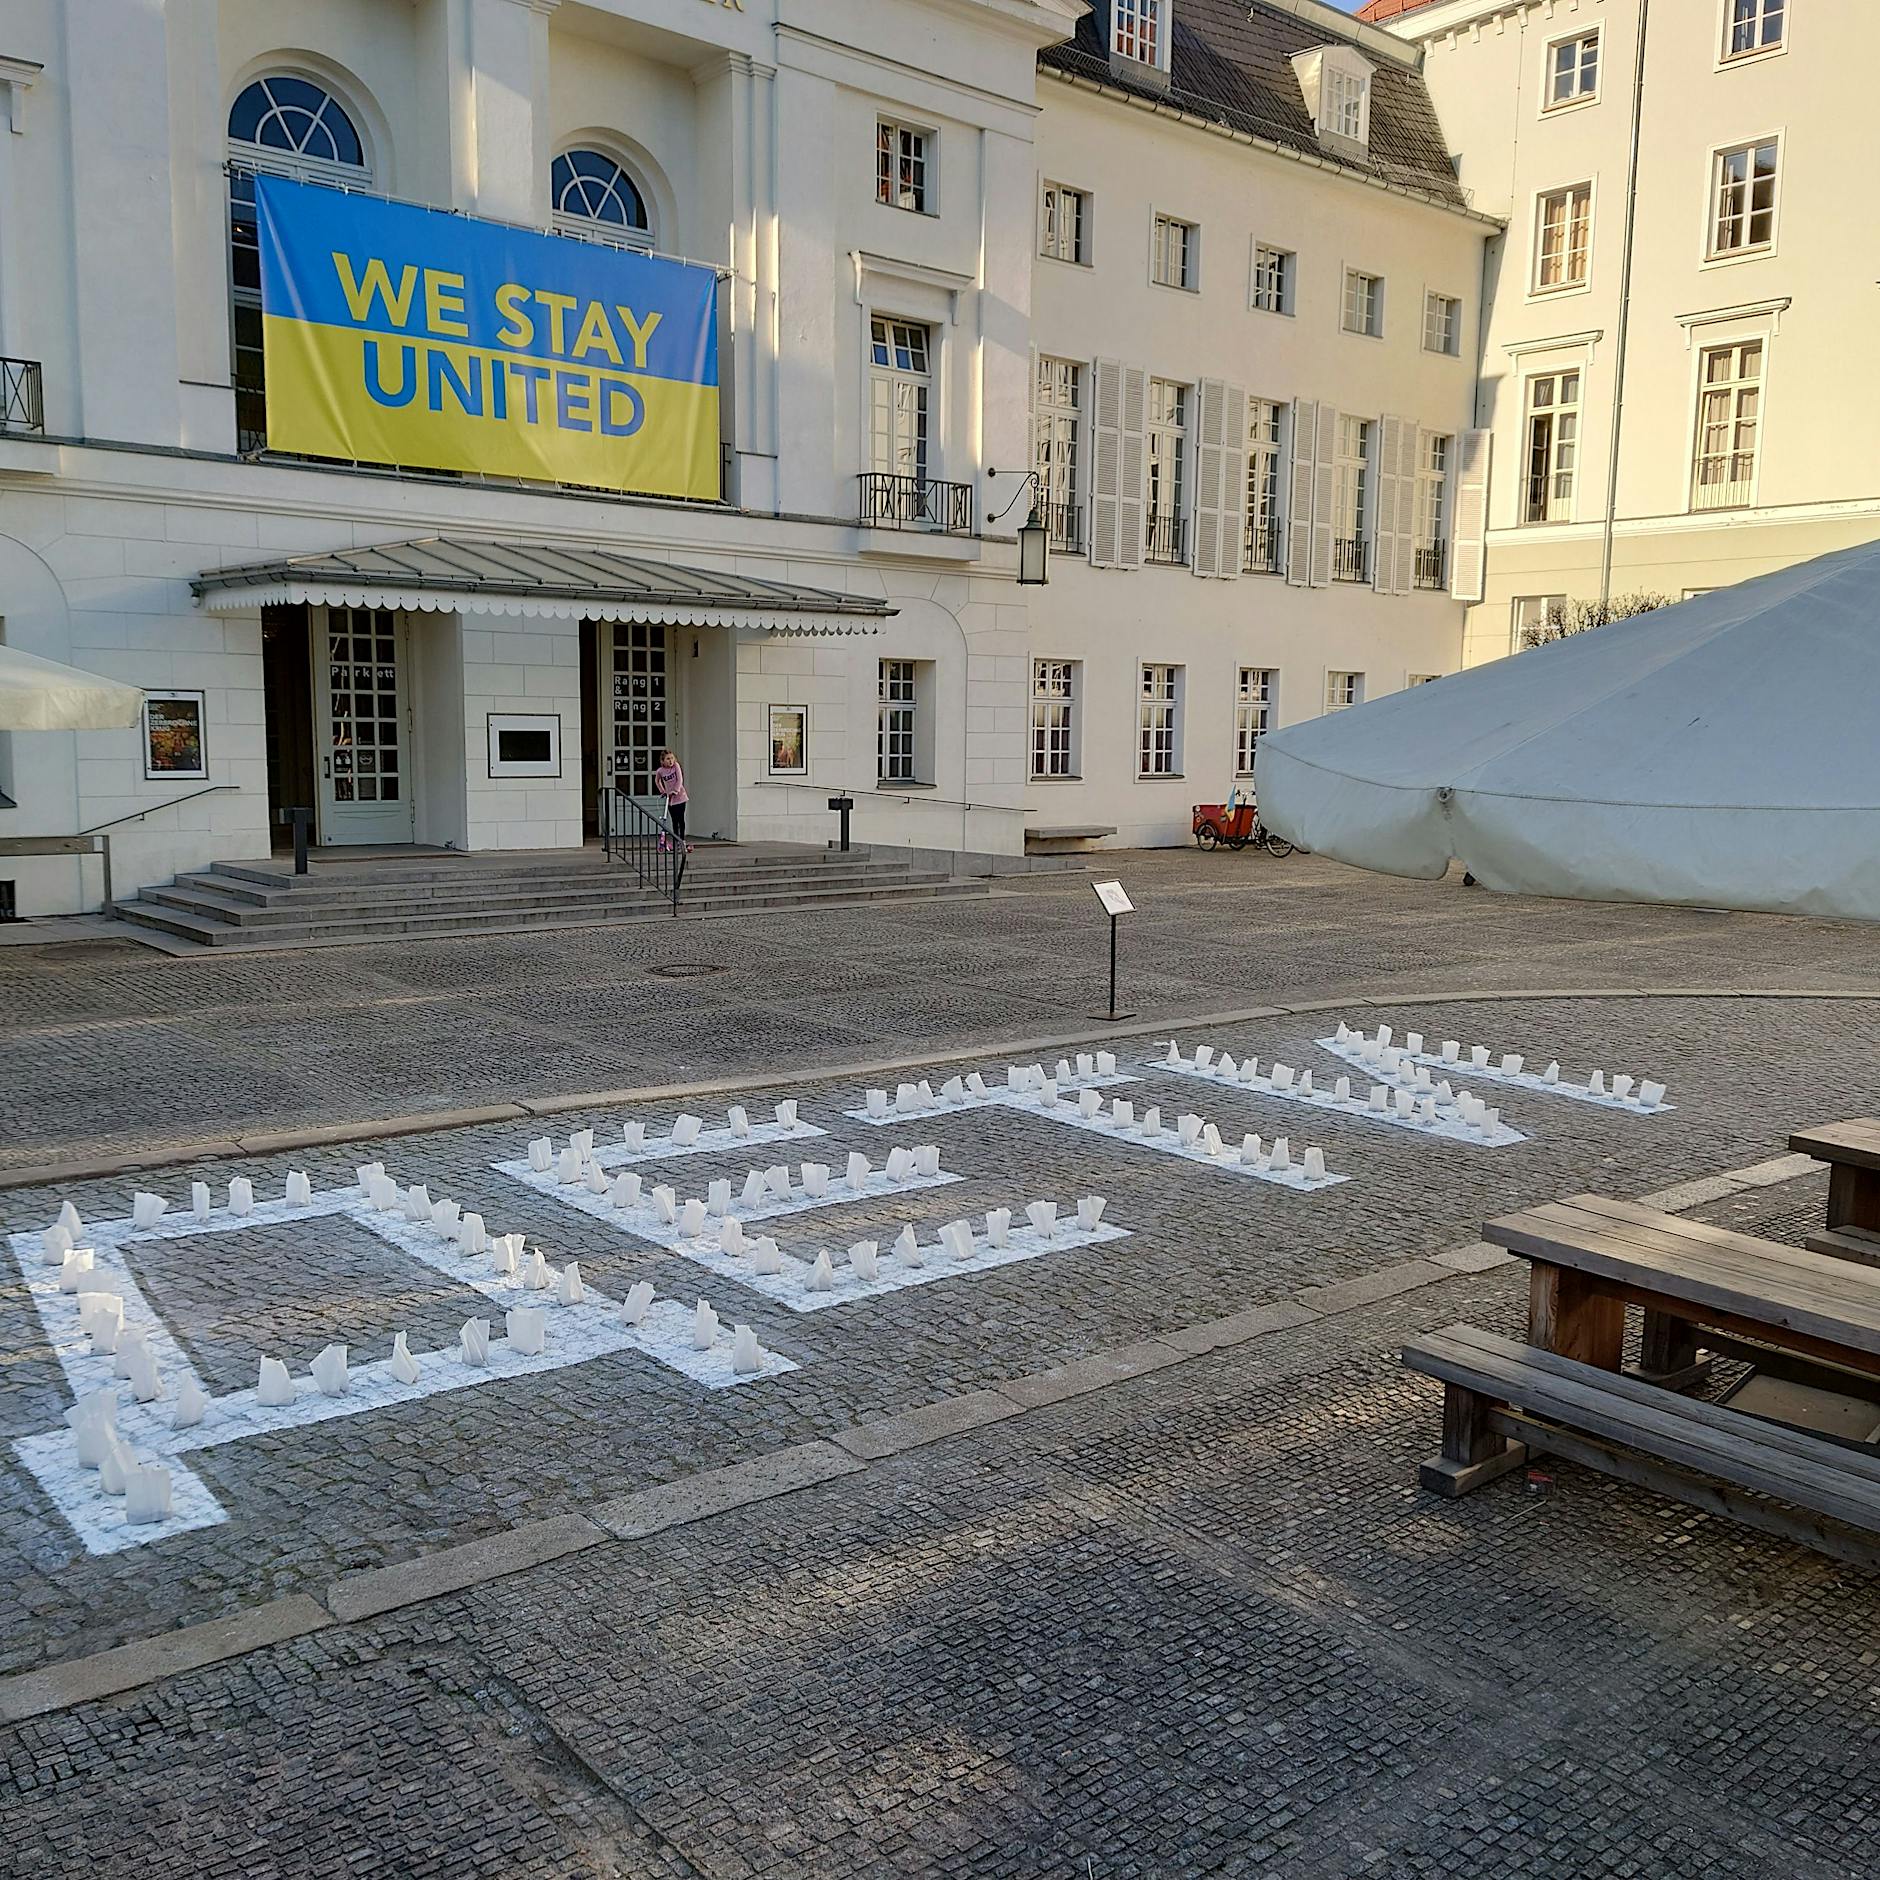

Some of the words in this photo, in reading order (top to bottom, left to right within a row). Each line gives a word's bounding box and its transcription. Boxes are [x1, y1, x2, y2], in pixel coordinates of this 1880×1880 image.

[331, 251, 469, 338] WE
[494, 283, 663, 368] STAY
[363, 340, 645, 437] UNITED
[331, 666, 394, 678] Parkett
[614, 675, 646, 688] Rang
[653, 677, 659, 686] 1
[614, 685, 622, 695] &
[614, 701, 646, 713] Rang
[654, 701, 661, 711] 2
